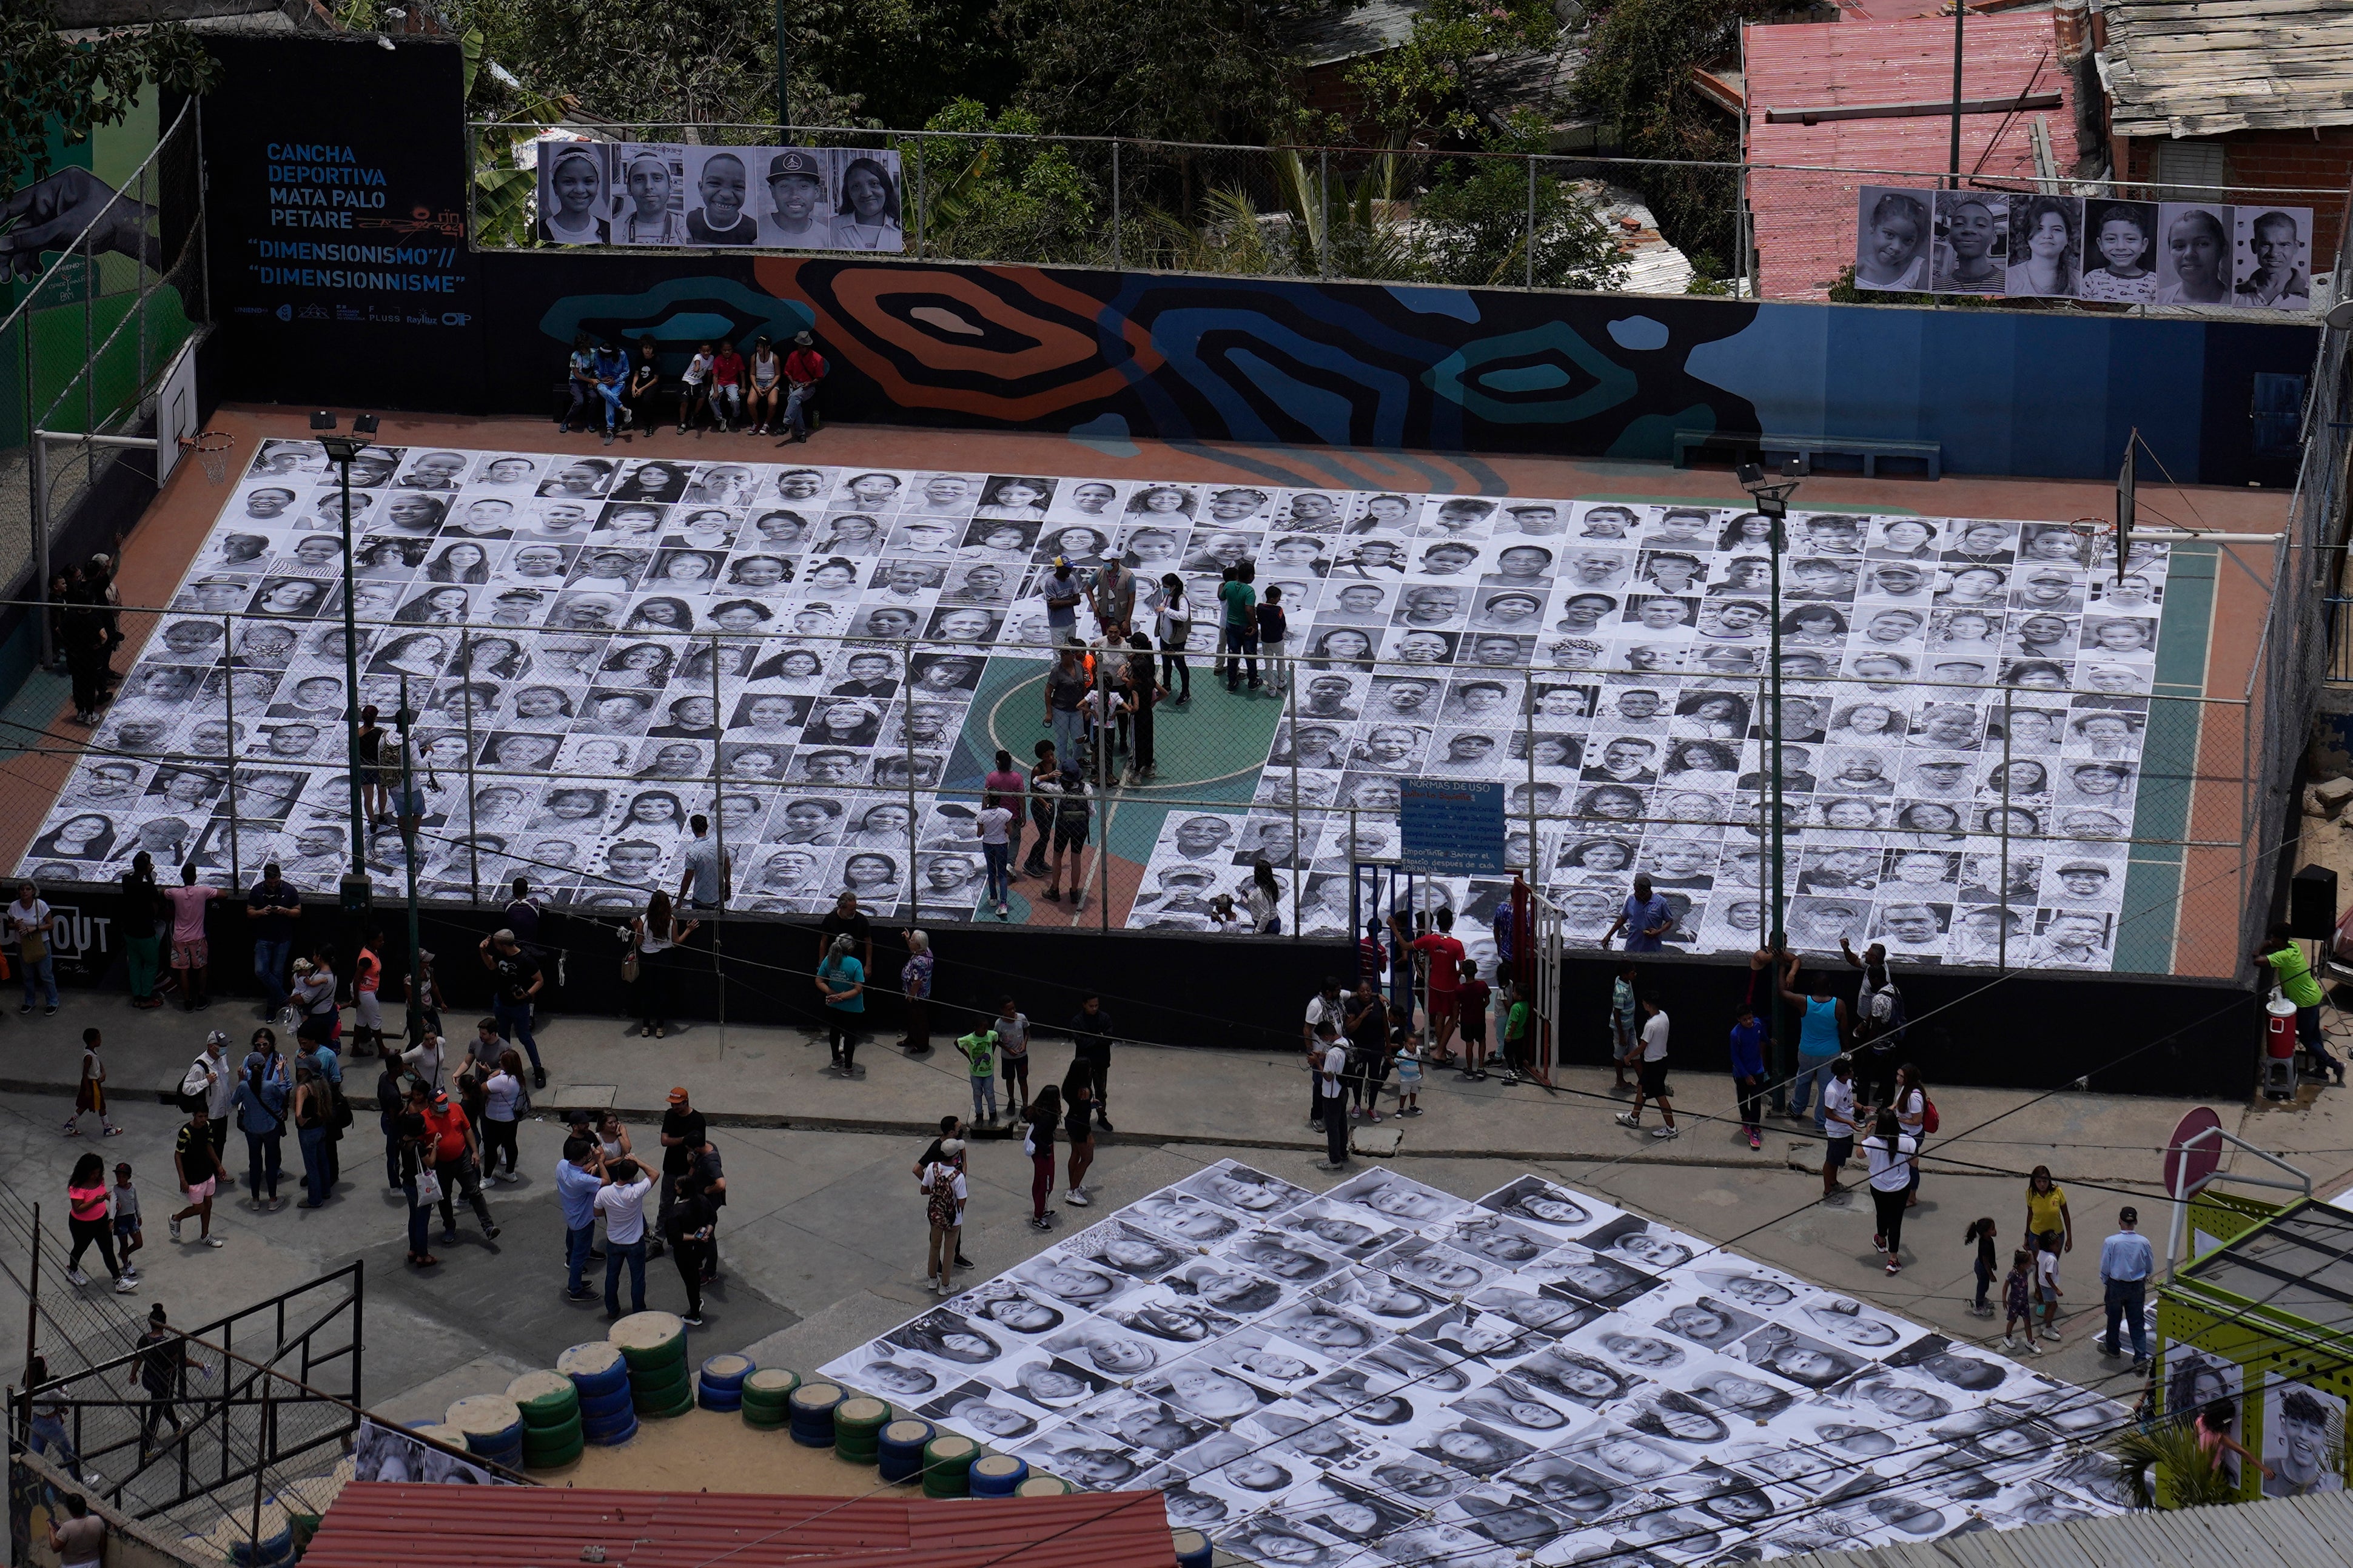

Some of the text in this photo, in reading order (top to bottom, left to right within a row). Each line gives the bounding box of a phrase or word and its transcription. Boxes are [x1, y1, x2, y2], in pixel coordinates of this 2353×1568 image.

[267, 143, 357, 164] CANCHA
[268, 164, 388, 186] DEPORTIVA
[270, 187, 386, 209] MATA PALO
[271, 209, 353, 229] PETARE
[369, 314, 400, 323] PLUSS
[1409, 780, 1490, 792] NORMAS DE USO
[1401, 864, 1438, 873] JORNADA
